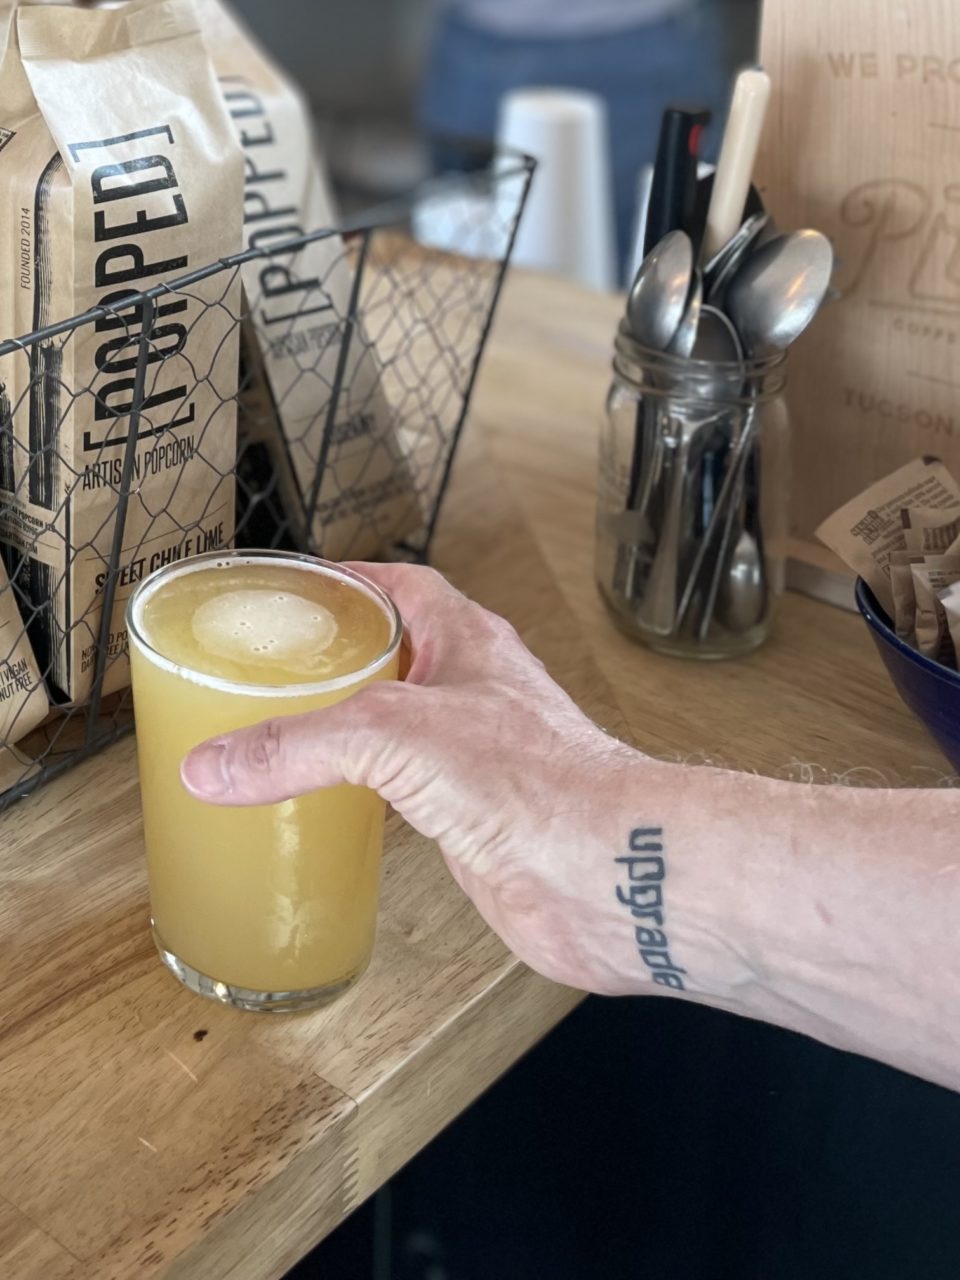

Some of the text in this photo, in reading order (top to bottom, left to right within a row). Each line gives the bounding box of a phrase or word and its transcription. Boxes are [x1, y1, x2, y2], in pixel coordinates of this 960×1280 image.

[826, 52, 878, 79] WE
[20, 207, 31, 290] FOUNDED 2014
[82, 436, 195, 491] ARTISN POPCORN
[4, 658, 29, 683] VEGAN
[14, 671, 33, 692] FREE
[613, 827, 688, 991] upgrade
